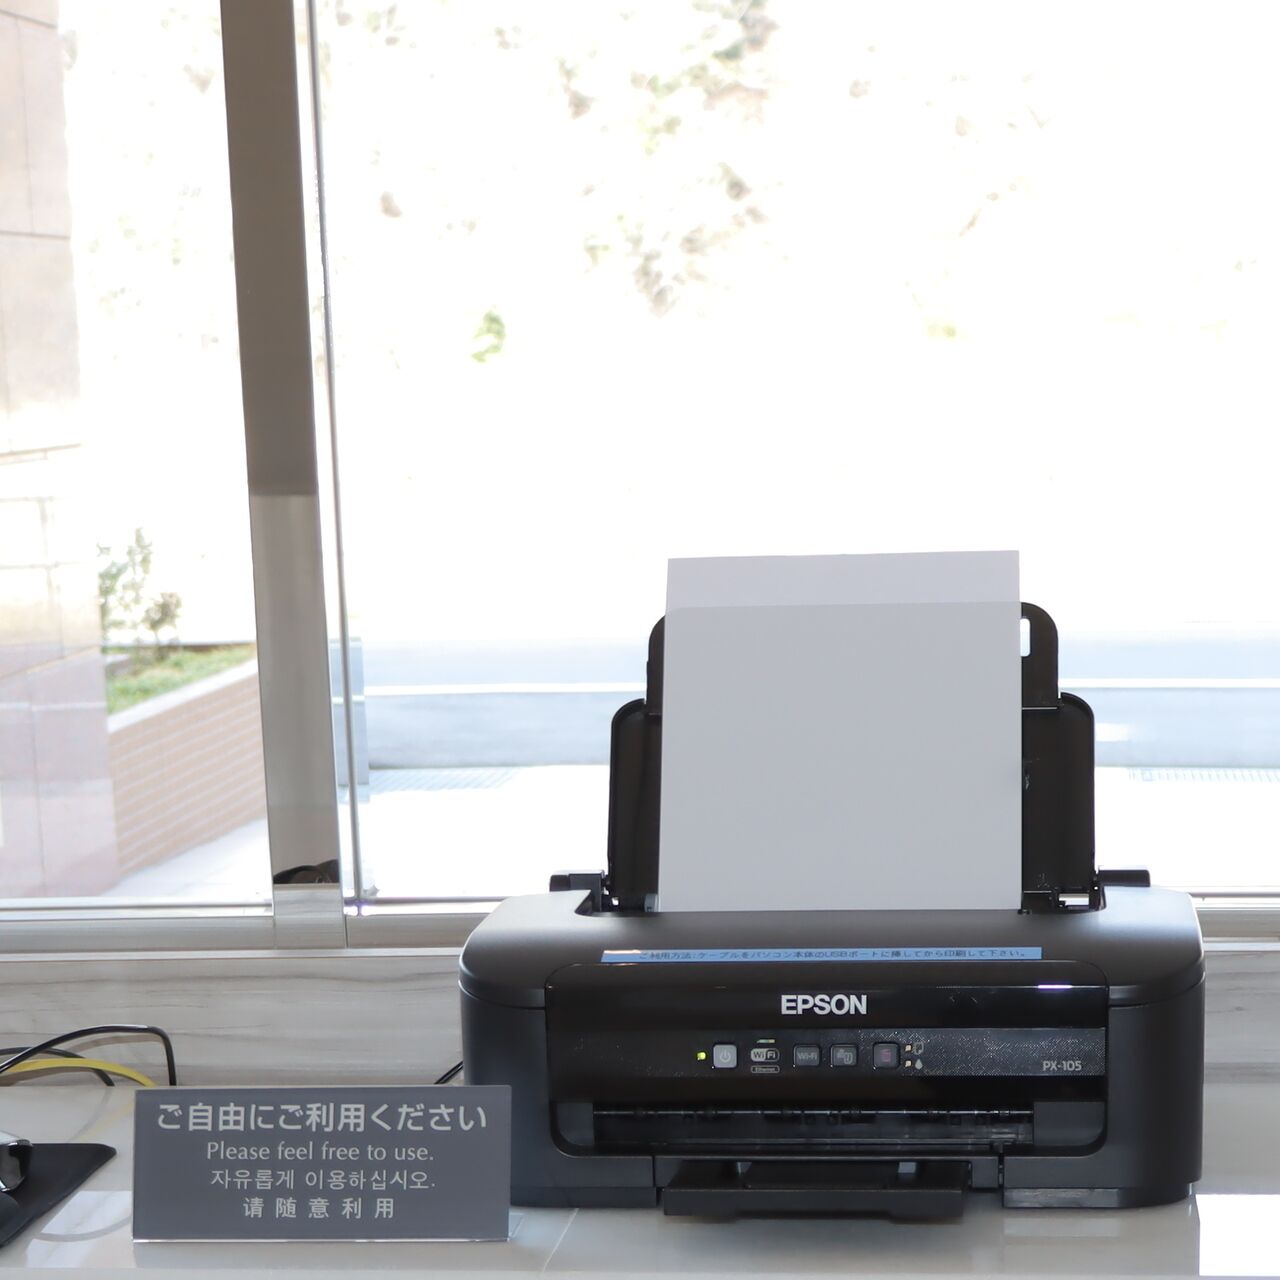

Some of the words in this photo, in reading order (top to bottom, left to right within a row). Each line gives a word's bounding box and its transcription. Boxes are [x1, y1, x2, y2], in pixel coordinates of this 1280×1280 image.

[780, 994, 868, 1016] EPSON
[1042, 1060, 1083, 1072] PX-105
[157, 1103, 487, 1132] ご自由にご利用ください
[206, 1142, 270, 1160] Please
[277, 1141, 313, 1160] feel
[321, 1142, 360, 1160] free
[367, 1145, 387, 1160] to
[395, 1147, 434, 1160] use.
[210, 1169, 295, 1190] 자유롭게
[305, 1169, 436, 1190] 이용하십시오.
